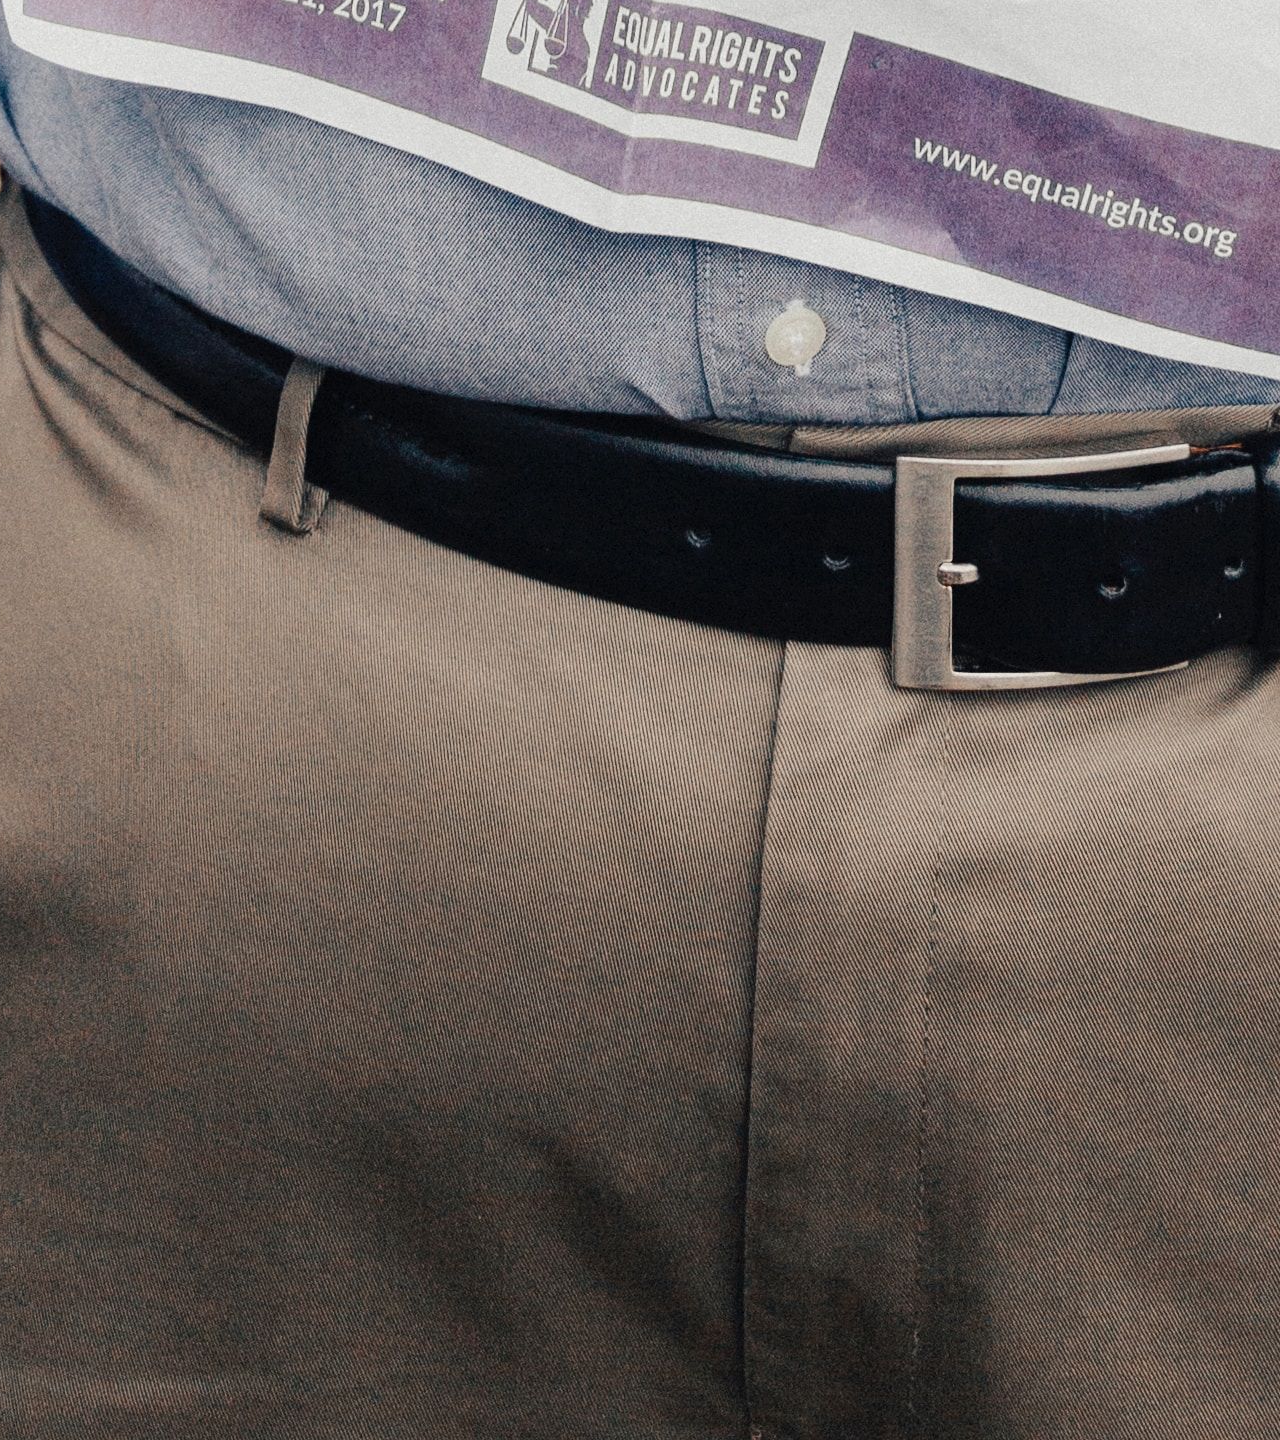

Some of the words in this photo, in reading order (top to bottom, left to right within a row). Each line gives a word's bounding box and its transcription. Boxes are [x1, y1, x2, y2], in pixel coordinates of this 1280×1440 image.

[613, 7, 686, 61] EQUAL
[690, 25, 803, 83] RIGHTS
[604, 54, 791, 120] ADVOCATES
[912, 135, 1239, 258] www.equalrights.org
